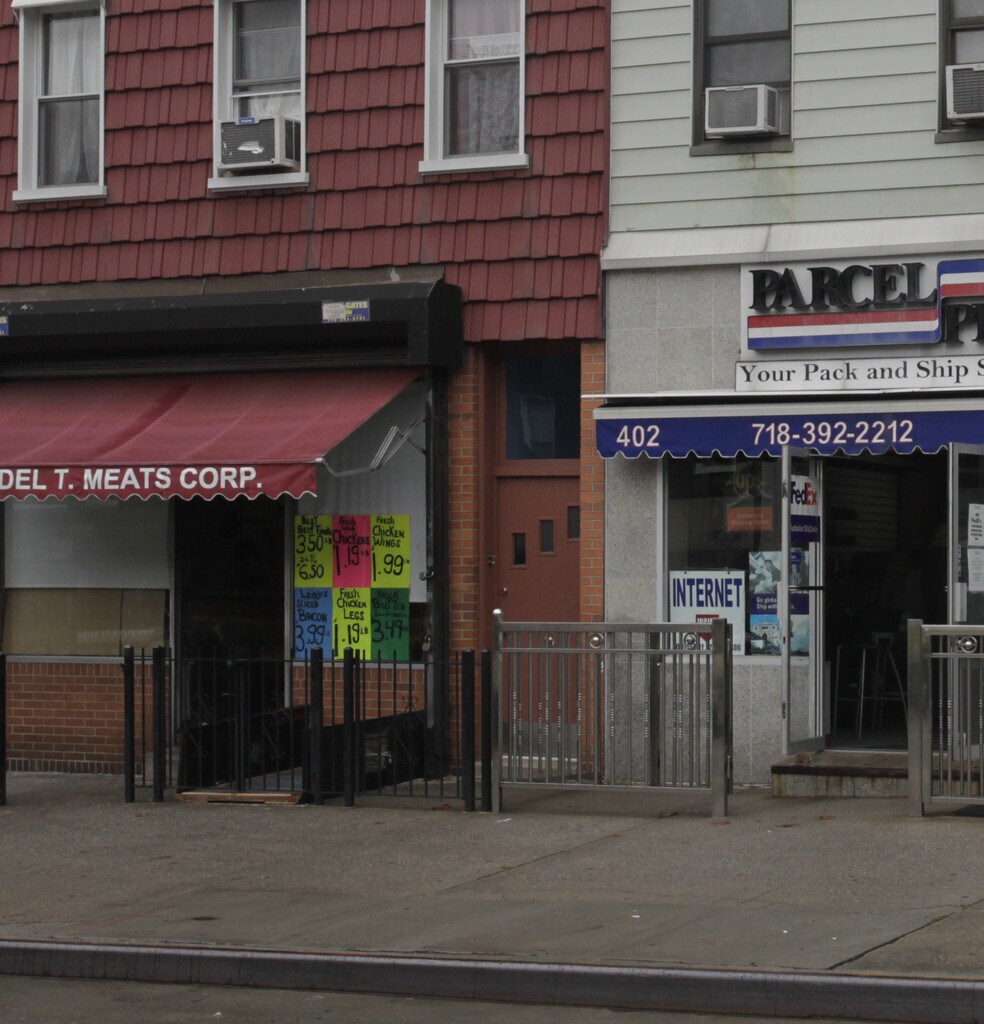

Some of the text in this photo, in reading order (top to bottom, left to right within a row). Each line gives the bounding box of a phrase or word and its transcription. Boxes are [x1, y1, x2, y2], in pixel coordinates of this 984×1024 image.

[749, 262, 937, 310] PARCEL
[740, 364, 795, 384] Your
[804, 360, 857, 382] Pack
[867, 360, 908, 379] and
[916, 357, 969, 384] Ship
[616, 425, 660, 447] 402
[752, 420, 913, 445] 718-392-2212
[55, 469, 74, 489] T.
[84, 467, 171, 489] MEATS
[180, 467, 262, 488] CORP.
[791, 481, 817, 505] FedEx
[374, 539, 401, 548] WINGS
[372, 553, 404, 582] 1.99
[672, 578, 743, 607] INTERNET
[298, 609, 328, 623] BACON
[344, 608, 364, 621] LEGS
